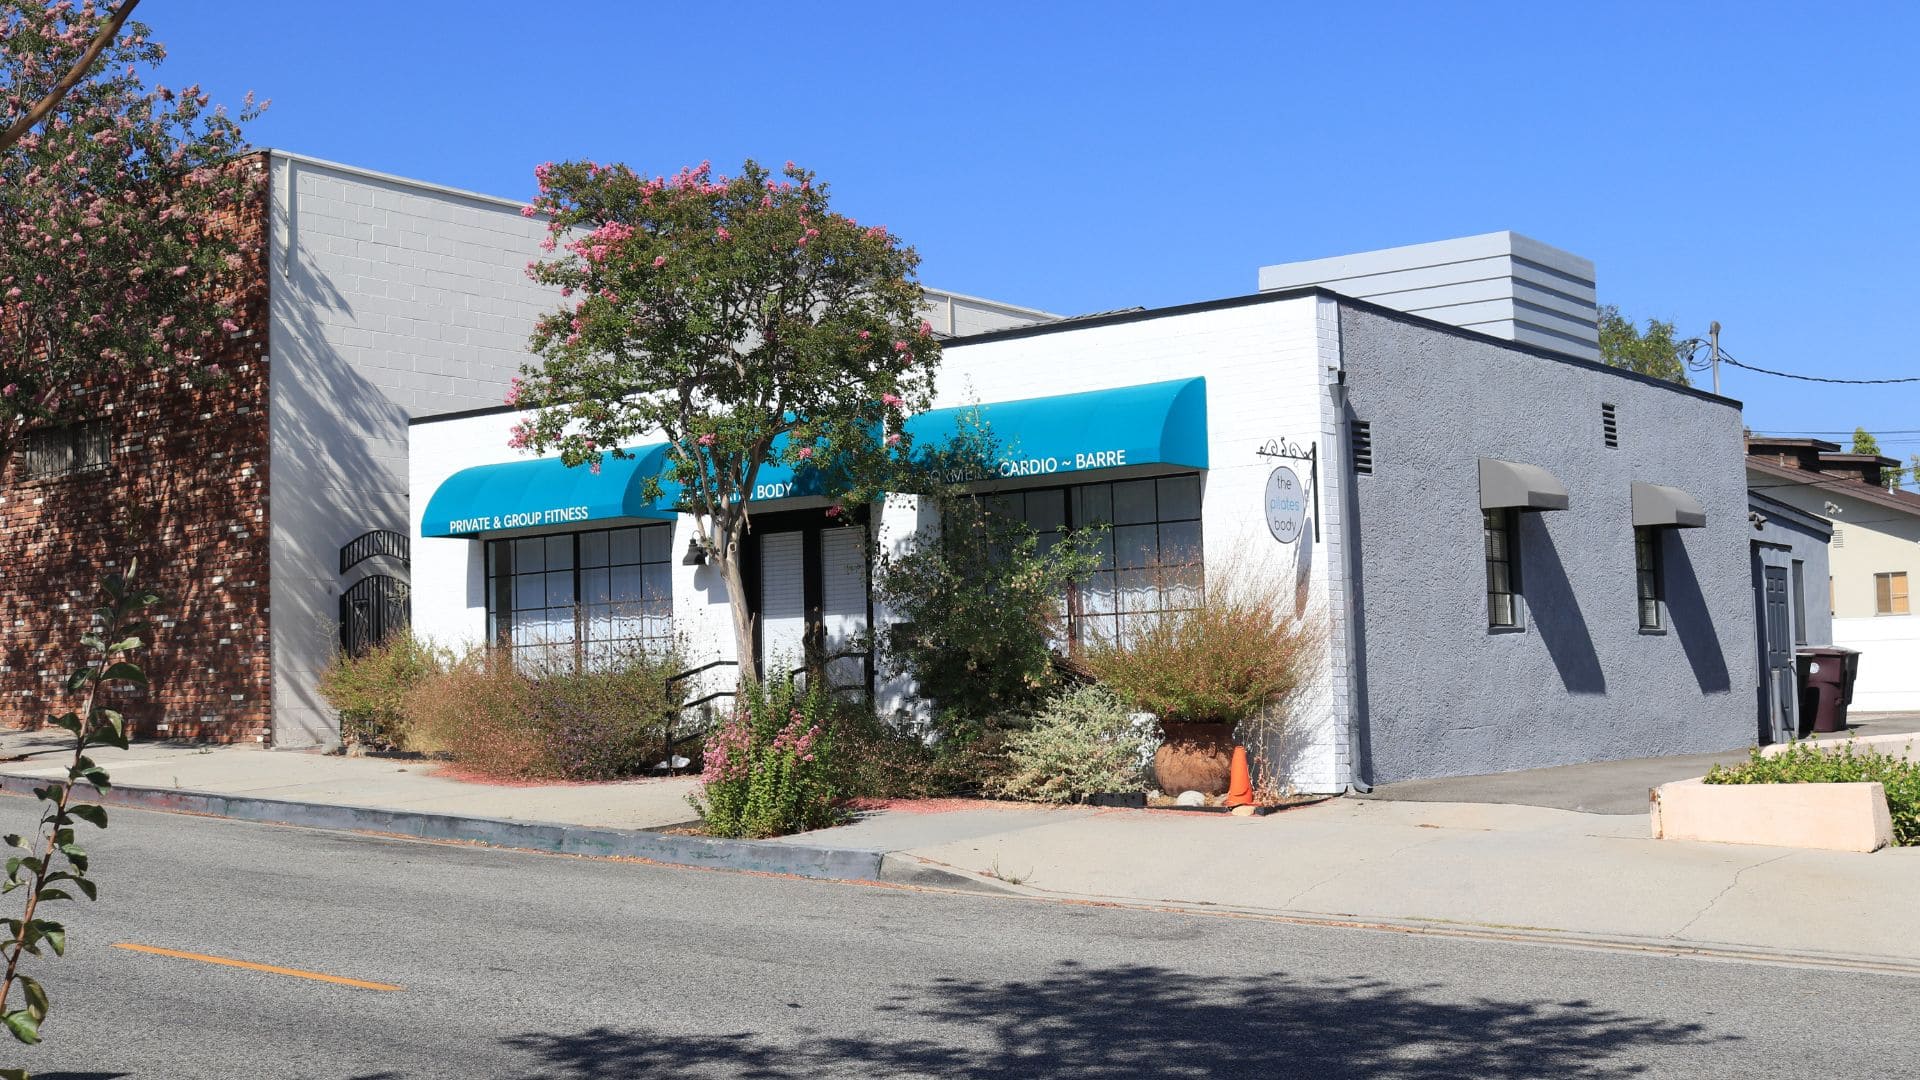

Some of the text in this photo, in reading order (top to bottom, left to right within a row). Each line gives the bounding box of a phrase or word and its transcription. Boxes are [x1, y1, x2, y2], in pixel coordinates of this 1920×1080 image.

[1000, 457, 1058, 477] CARDIO
[1075, 449, 1127, 469] BARRE
[757, 482, 794, 499] BODY
[1276, 475, 1292, 490] the
[1270, 496, 1300, 512] pilates
[449, 505, 589, 534] PRIVATE & GROUP FITNESS
[1274, 517, 1296, 535] body
